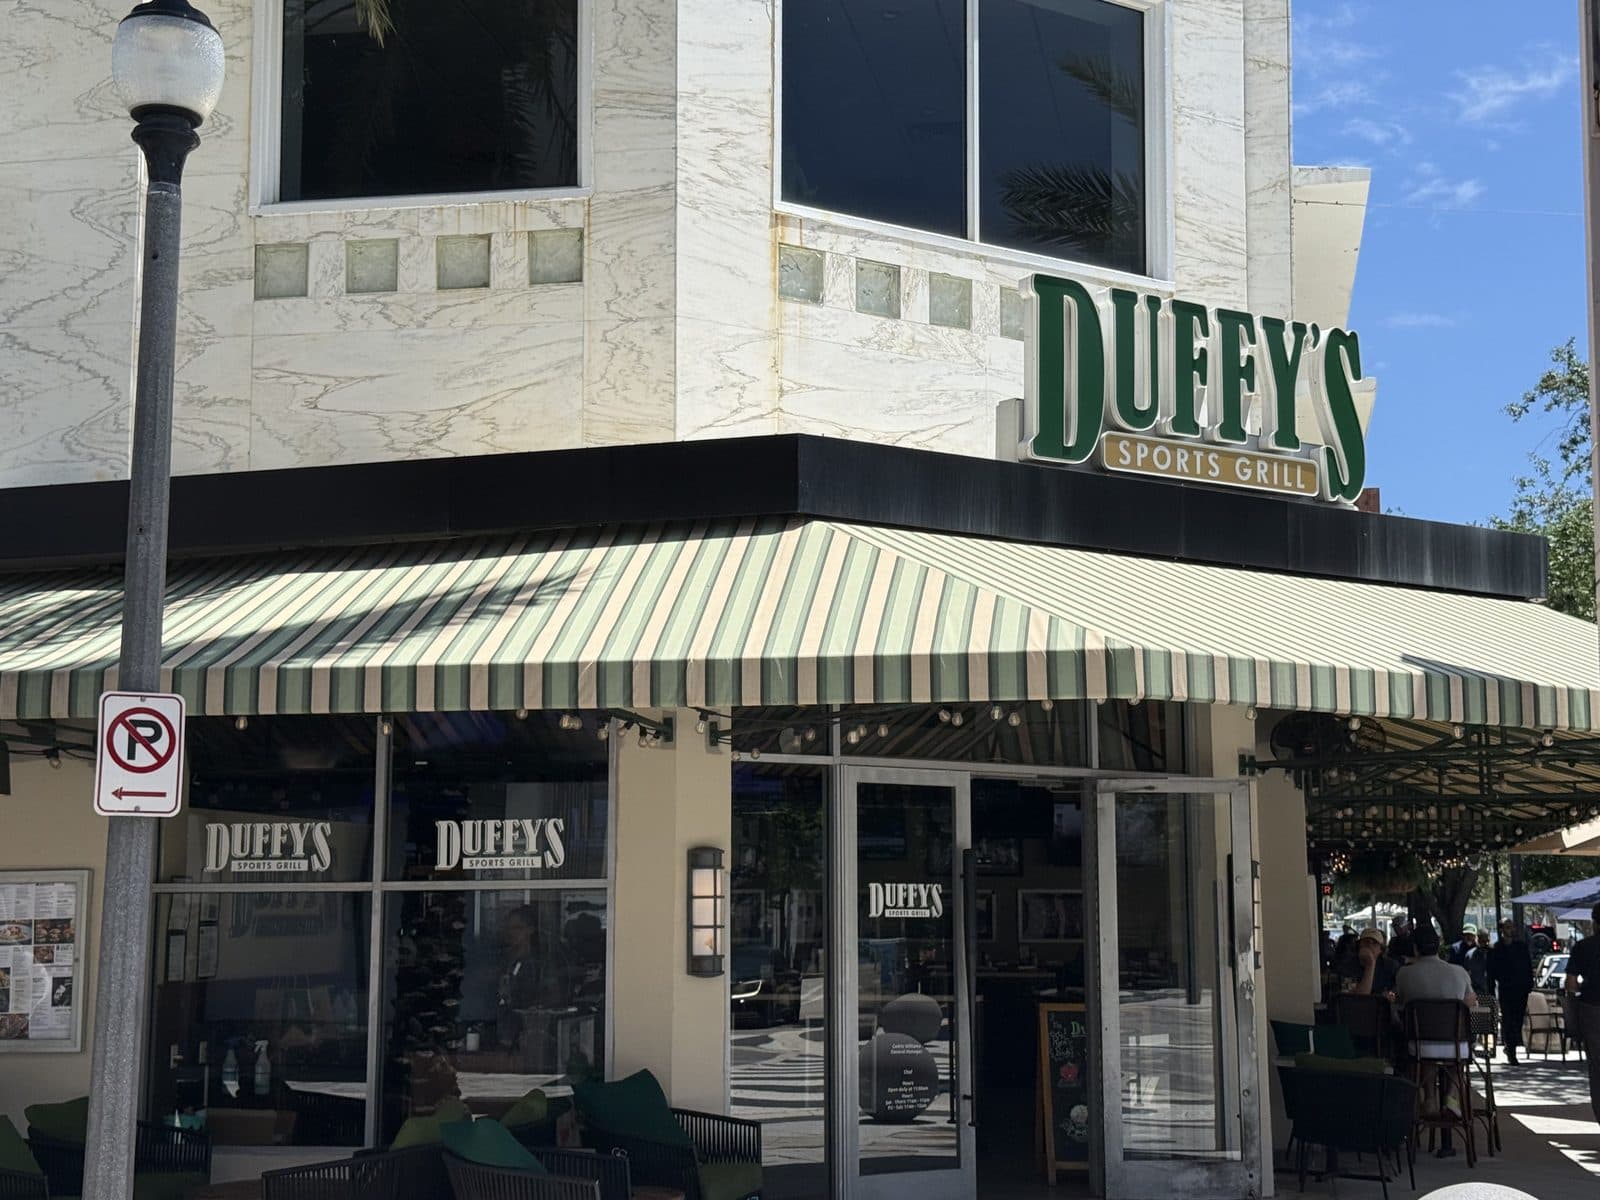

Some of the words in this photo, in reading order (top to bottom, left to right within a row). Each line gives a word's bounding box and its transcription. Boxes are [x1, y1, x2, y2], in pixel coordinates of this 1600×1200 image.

[1027, 273, 1366, 504] DUFFY'S
[1119, 440, 1220, 478] SPORTS
[1235, 456, 1305, 489] GRILL
[127, 719, 163, 760] P
[238, 862, 272, 870] SPORTS
[469, 859, 504, 867] SPORTS
[509, 858, 535, 866] GRILL
